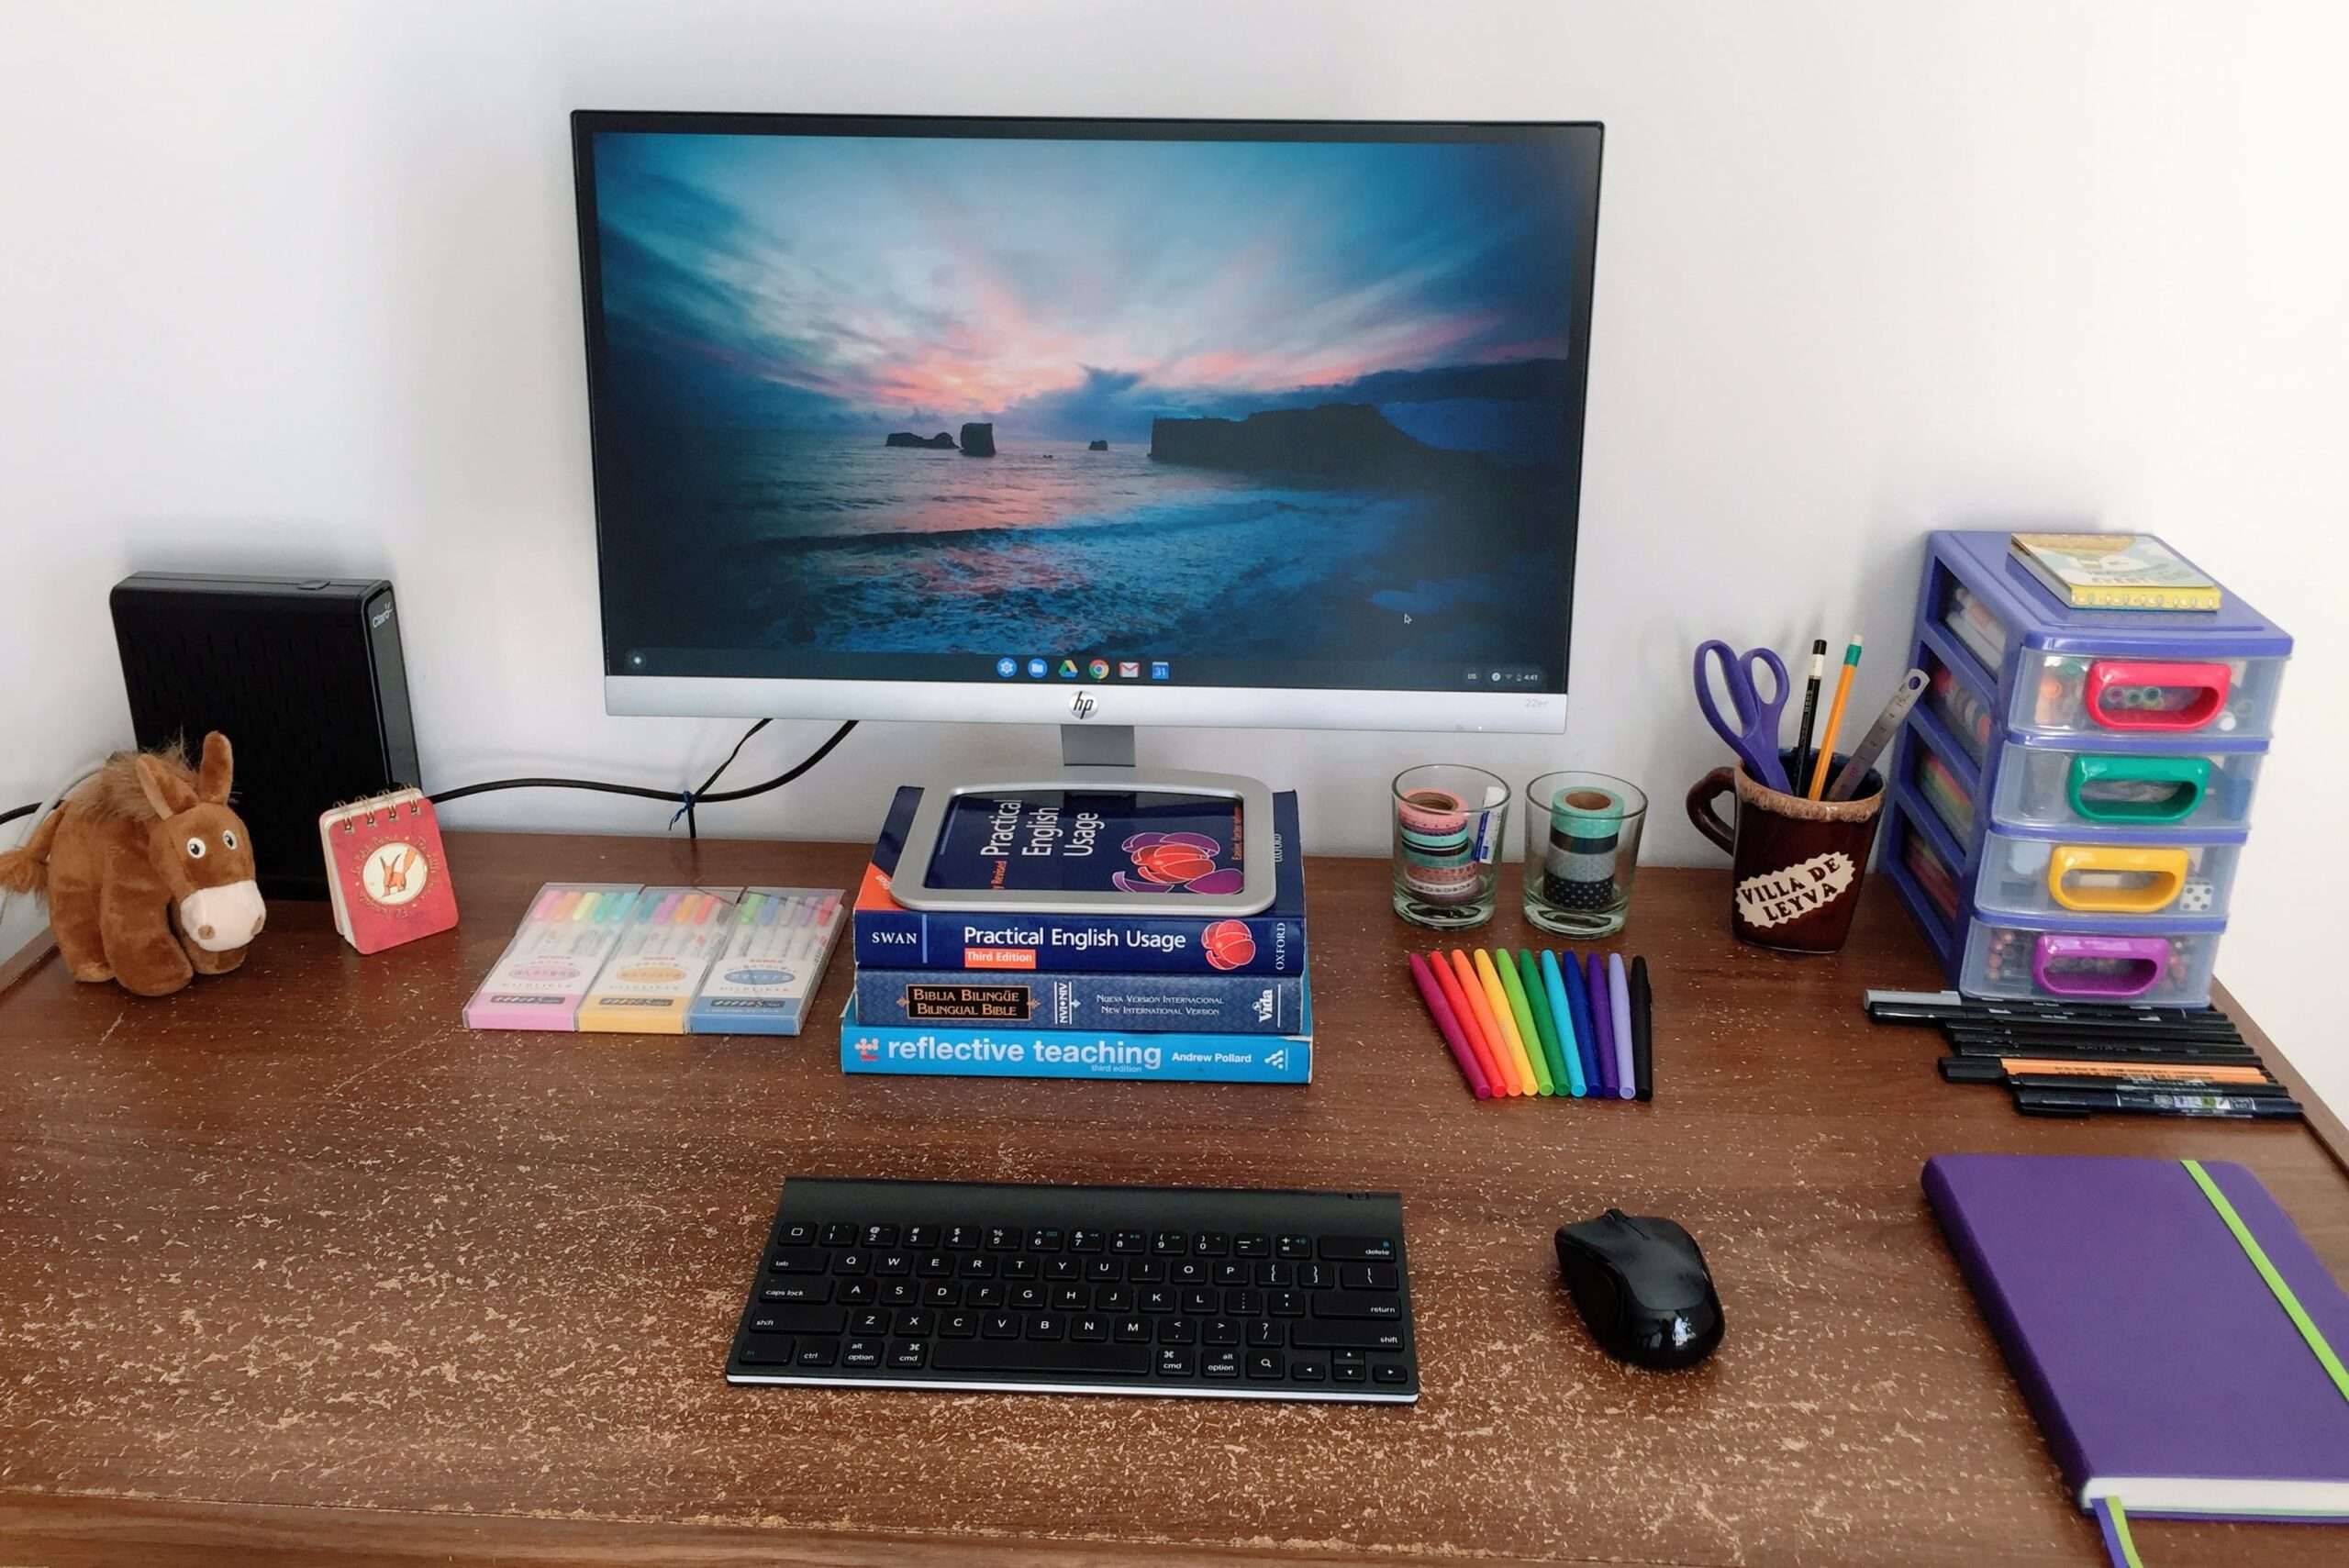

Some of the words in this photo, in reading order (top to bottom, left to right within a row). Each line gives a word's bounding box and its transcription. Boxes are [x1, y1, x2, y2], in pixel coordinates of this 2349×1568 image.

[1155, 667, 1167, 677] 31
[1073, 690, 1095, 720] hp
[980, 799, 1022, 856] Practical
[1021, 806, 1063, 856] English
[1063, 812, 1106, 856] Usage
[1742, 876, 1806, 906] VILLA
[1808, 857, 1841, 883] DE
[1762, 882, 1838, 921] LEYVA
[873, 932, 917, 943] SWAN
[965, 927, 1043, 944] Practical
[1052, 929, 1119, 950] English
[1127, 930, 1186, 951] Usage
[1276, 923, 1286, 970] OXFORD
[967, 951, 993, 962] Third
[996, 952, 1032, 962] Edition
[914, 989, 955, 1001] BIBLIA
[962, 989, 1019, 1001] BILINGÜE
[918, 1003, 978, 1015] BILINGUAL
[983, 1004, 1017, 1016] BIBLE
[1259, 989, 1273, 1022] Vida
[889, 1037, 1024, 1061] reflective
[1033, 1040, 1162, 1070] teaching
[1172, 1052, 1212, 1062] Andrew
[1215, 1053, 1252, 1062] Pollard
